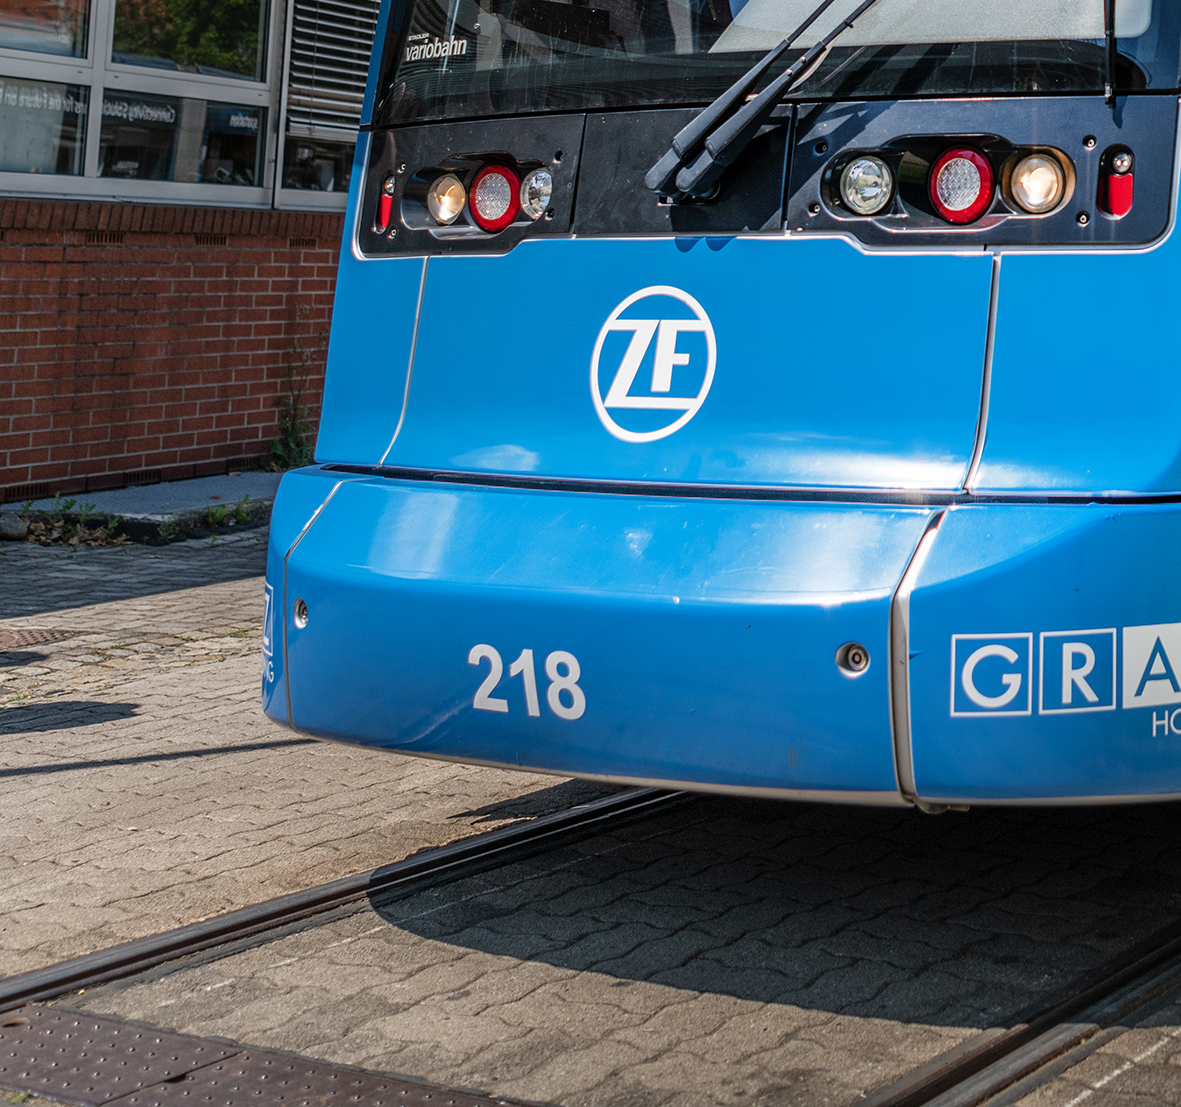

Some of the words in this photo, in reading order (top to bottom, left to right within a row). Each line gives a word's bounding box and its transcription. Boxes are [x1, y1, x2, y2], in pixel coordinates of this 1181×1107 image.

[405, 35, 468, 62] variobahn
[599, 306, 713, 417] ZF
[467, 643, 587, 720] 218
